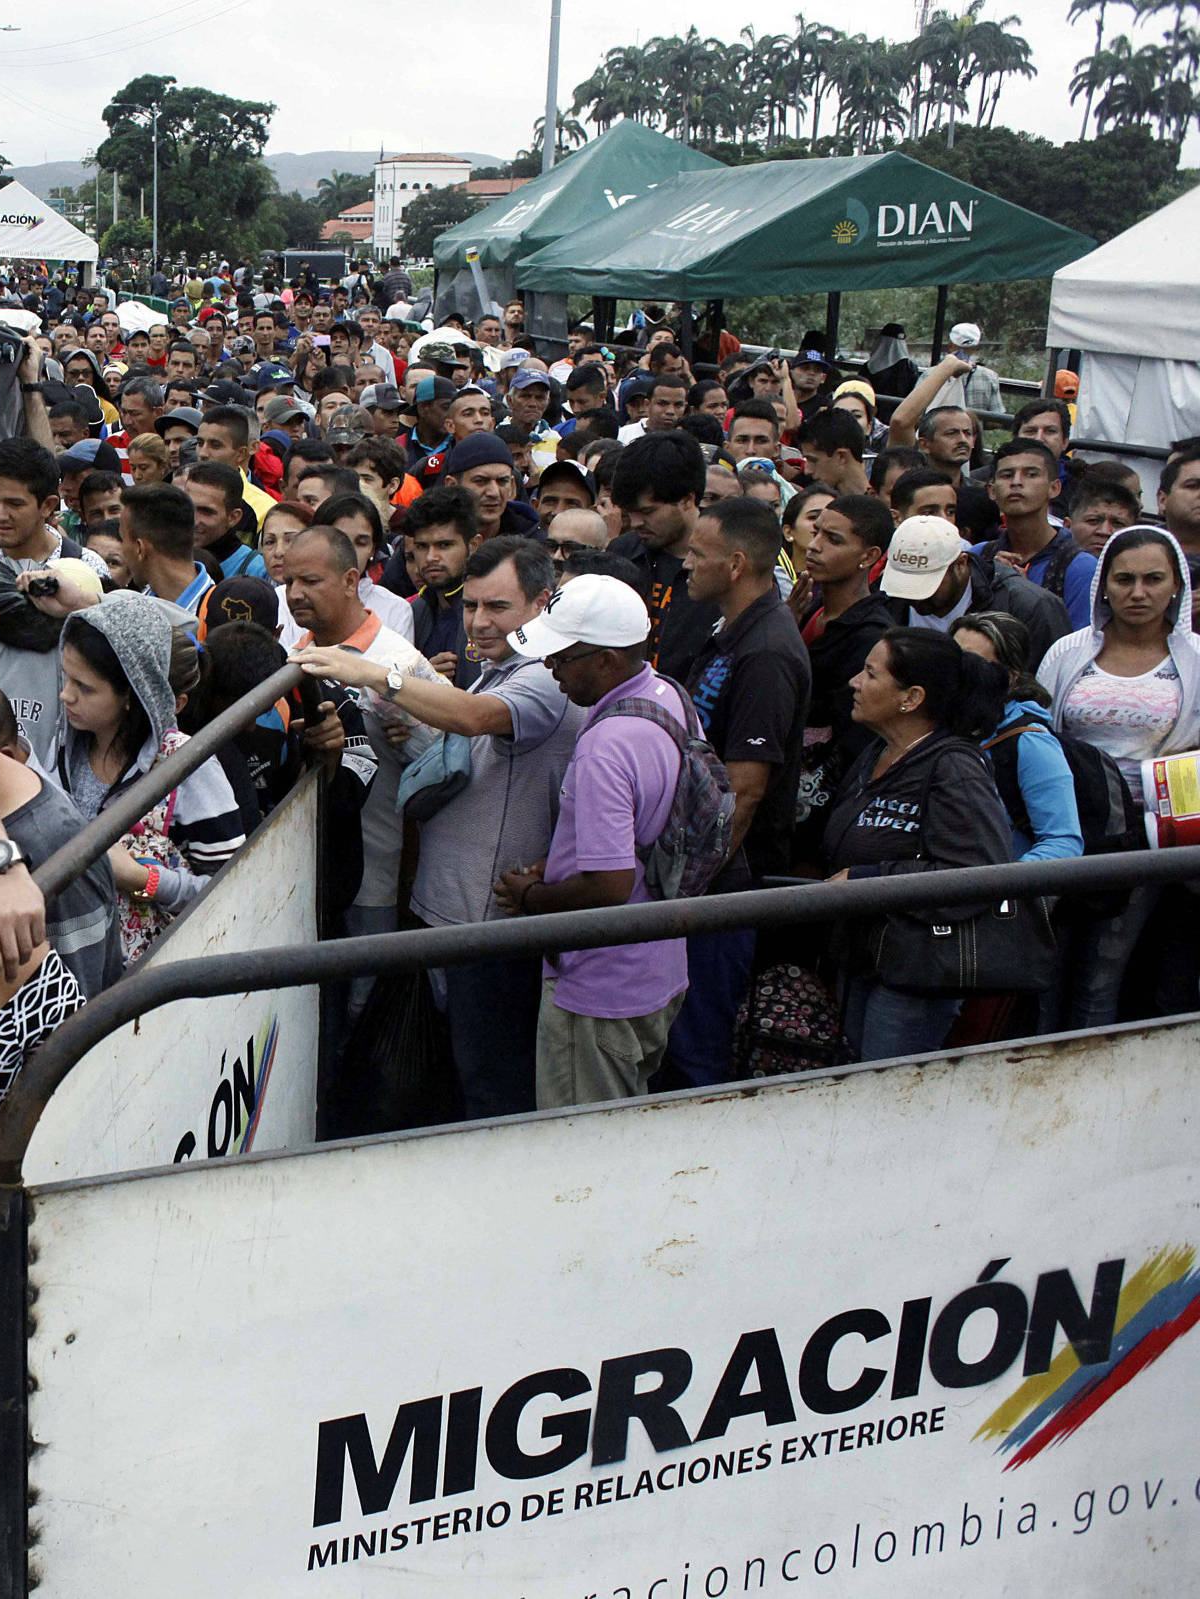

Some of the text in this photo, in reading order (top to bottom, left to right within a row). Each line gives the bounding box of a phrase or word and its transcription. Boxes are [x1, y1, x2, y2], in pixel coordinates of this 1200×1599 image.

[877, 200, 974, 237] DIAN
[892, 549, 929, 568] Jeep
[313, 1257, 1126, 1528] MIGRACIÓN
[307, 1406, 946, 1571] MINISTERIO DE RELACIONES EXTERIORE
